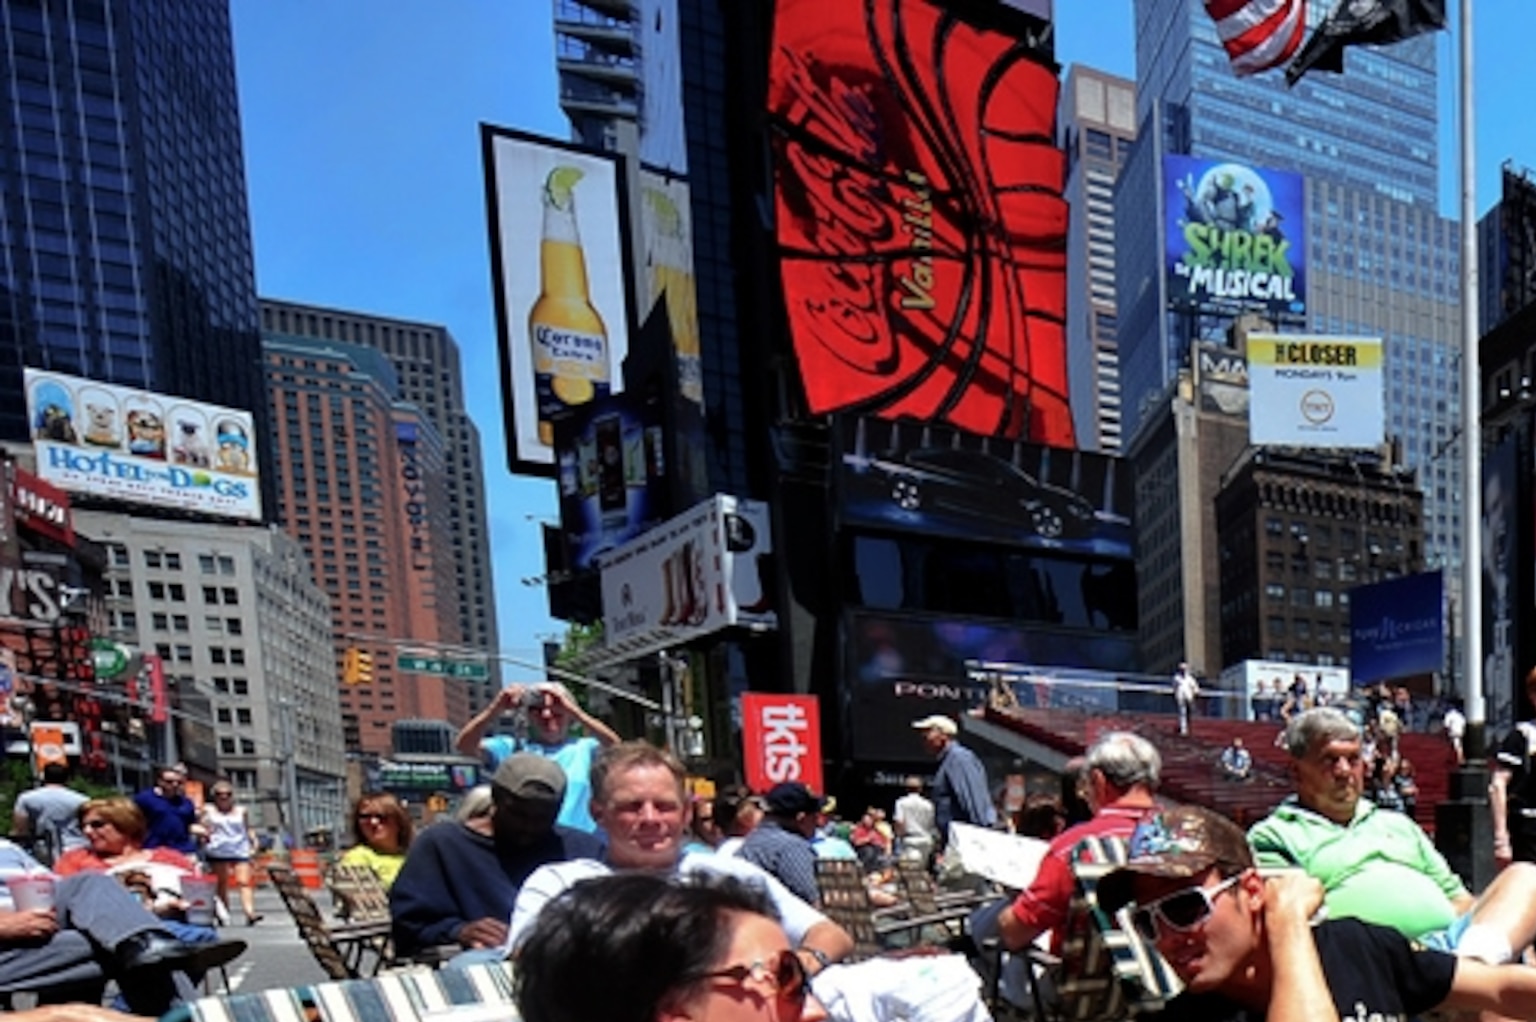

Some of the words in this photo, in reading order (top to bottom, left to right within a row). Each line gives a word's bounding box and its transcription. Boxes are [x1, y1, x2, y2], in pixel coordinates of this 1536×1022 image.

[1183, 220, 1295, 279] SHREK
[1188, 264, 1296, 300] MUSICAL
[1288, 342, 1357, 366] CLOSER
[47, 445, 145, 481] HOTEL
[761, 702, 808, 785] tkts
